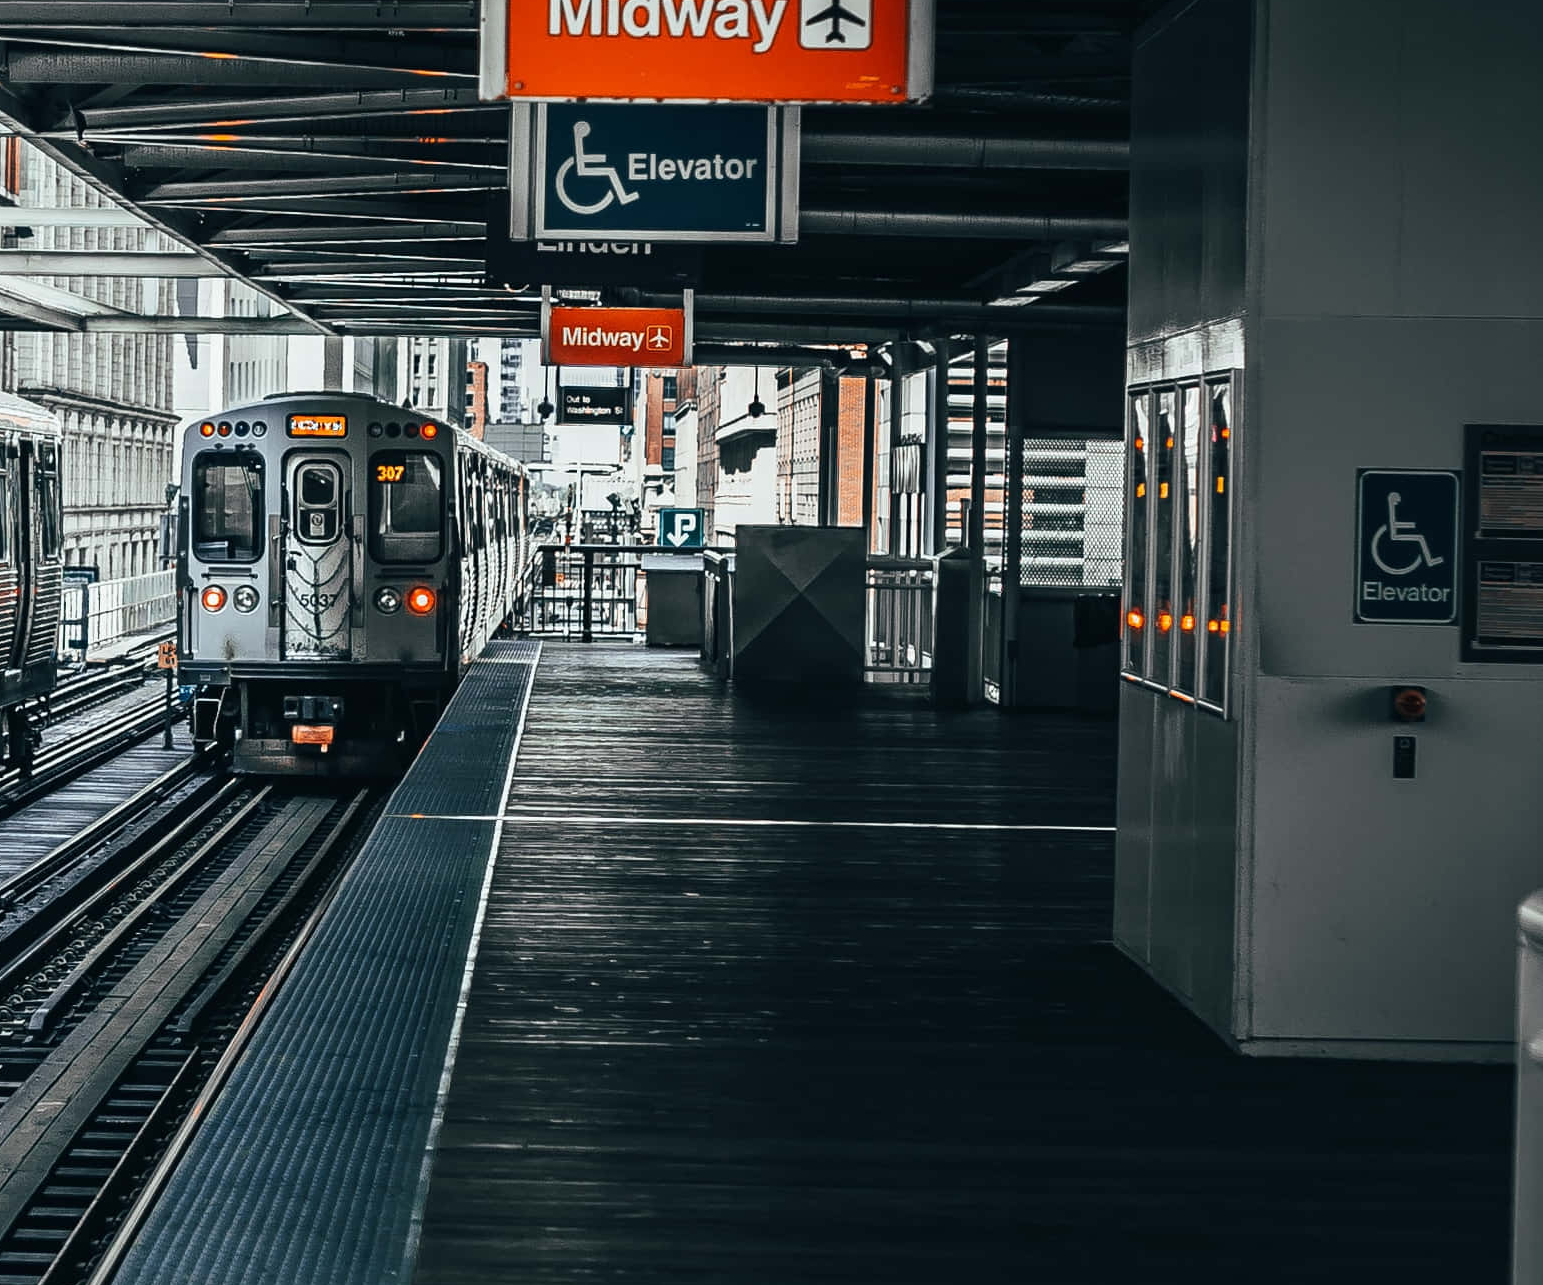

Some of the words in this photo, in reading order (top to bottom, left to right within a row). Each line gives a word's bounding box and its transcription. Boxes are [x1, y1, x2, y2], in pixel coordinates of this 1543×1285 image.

[628, 153, 757, 180] Elevator
[562, 326, 645, 352] Midway
[377, 466, 404, 482] 307
[300, 594, 339, 607] 5037
[1363, 581, 1451, 602] Elevator
